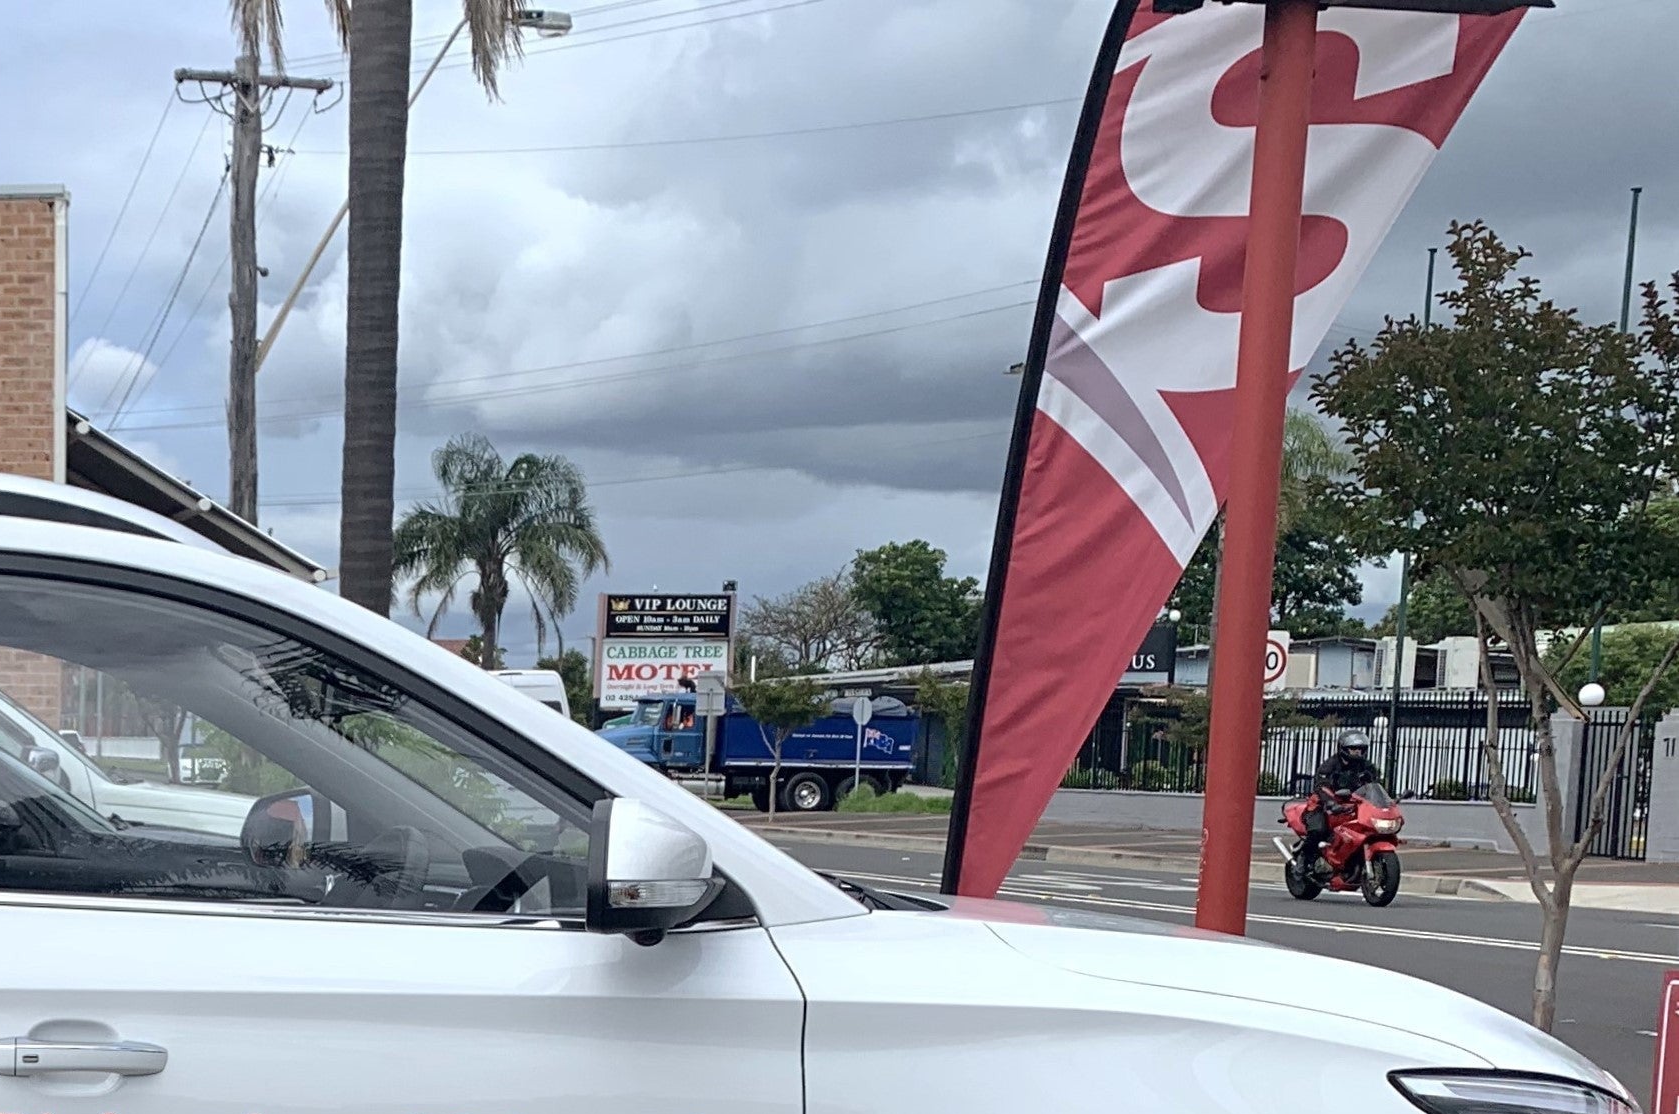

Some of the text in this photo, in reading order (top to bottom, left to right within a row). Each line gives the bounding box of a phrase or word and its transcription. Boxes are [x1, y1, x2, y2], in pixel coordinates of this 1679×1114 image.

[634, 598, 727, 611] VIP LOUNGE
[615, 615, 641, 624] OPEN
[693, 615, 720, 624] DAILY
[607, 645, 724, 659] CABBAGE TREE
